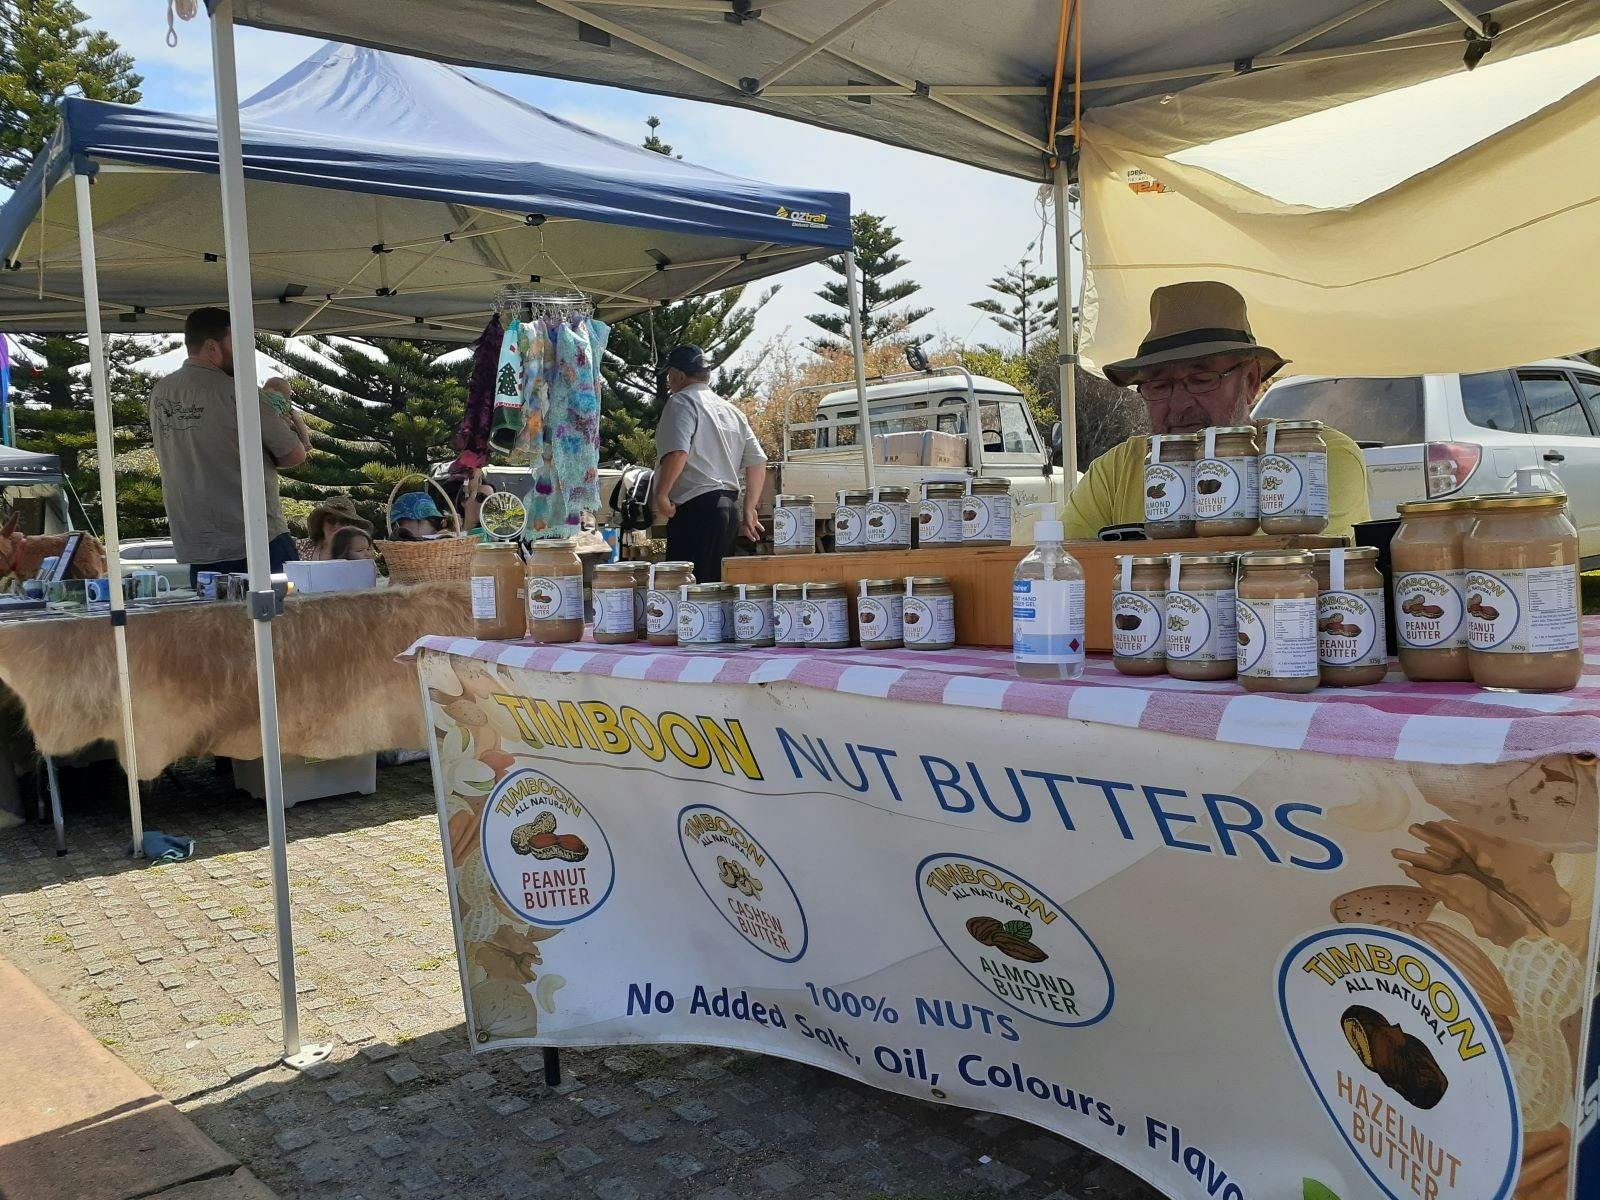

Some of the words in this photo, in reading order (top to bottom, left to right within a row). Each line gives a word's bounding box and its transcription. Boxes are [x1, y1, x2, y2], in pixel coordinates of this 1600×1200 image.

[791, 211, 827, 223] OZtrail
[1146, 467, 1177, 481] MBOON
[1196, 463, 1230, 477] MBOON
[1260, 458, 1293, 473] MBOON
[1412, 587, 1436, 596] NATURAL
[1466, 576, 1506, 598] MBOON
[1113, 596, 1152, 614] MBOON
[1167, 596, 1200, 614] MBOON
[1318, 596, 1368, 616] MBOON
[1329, 606, 1356, 615] NATURAL
[1406, 621, 1440, 630] PEANUT
[1406, 630, 1440, 640] BUTTER
[1167, 635, 1192, 644] ASHEW
[1167, 644, 1190, 652] UTTER
[1320, 638, 1358, 649] PEANUT
[1320, 648, 1357, 658] BUTTER
[493, 693, 764, 781] TIMBOON
[775, 727, 903, 801] NUT
[919, 755, 1344, 871] BUTTERS
[495, 778, 582, 818] TIMBOON
[514, 800, 530, 818] ALL
[531, 796, 568, 815] NATURAL
[684, 814, 766, 868] TIMBOON
[702, 834, 713, 848] ALL
[712, 834, 750, 861] NATURAL
[522, 868, 586, 890] PEANUT
[524, 888, 590, 910] BUTTER
[926, 864, 1058, 925] TIMBOON
[952, 888, 968, 901] ALL
[969, 888, 1030, 918] NATURAL
[728, 898, 784, 934] CASHEW
[738, 916, 790, 952] BUTTER
[980, 956, 1074, 996] ALMOND
[993, 978, 1080, 1016] BUTTER
[1302, 942, 1487, 1062] TIMBOON
[805, 981, 899, 1024] 100%
[914, 997, 1020, 1042] NUTS
[1345, 977, 1374, 994] ALL
[1376, 978, 1446, 1045] NATURAL
[626, 983, 675, 1016] No
[689, 985, 788, 1029] Added
[794, 1013, 861, 1065] Salt,
[873, 1045, 940, 1086] Oil,
[958, 1054, 1127, 1137] Colours,
[1336, 1070, 1462, 1188] HAZELNUT
[1352, 1111, 1439, 1200] BUTTER
